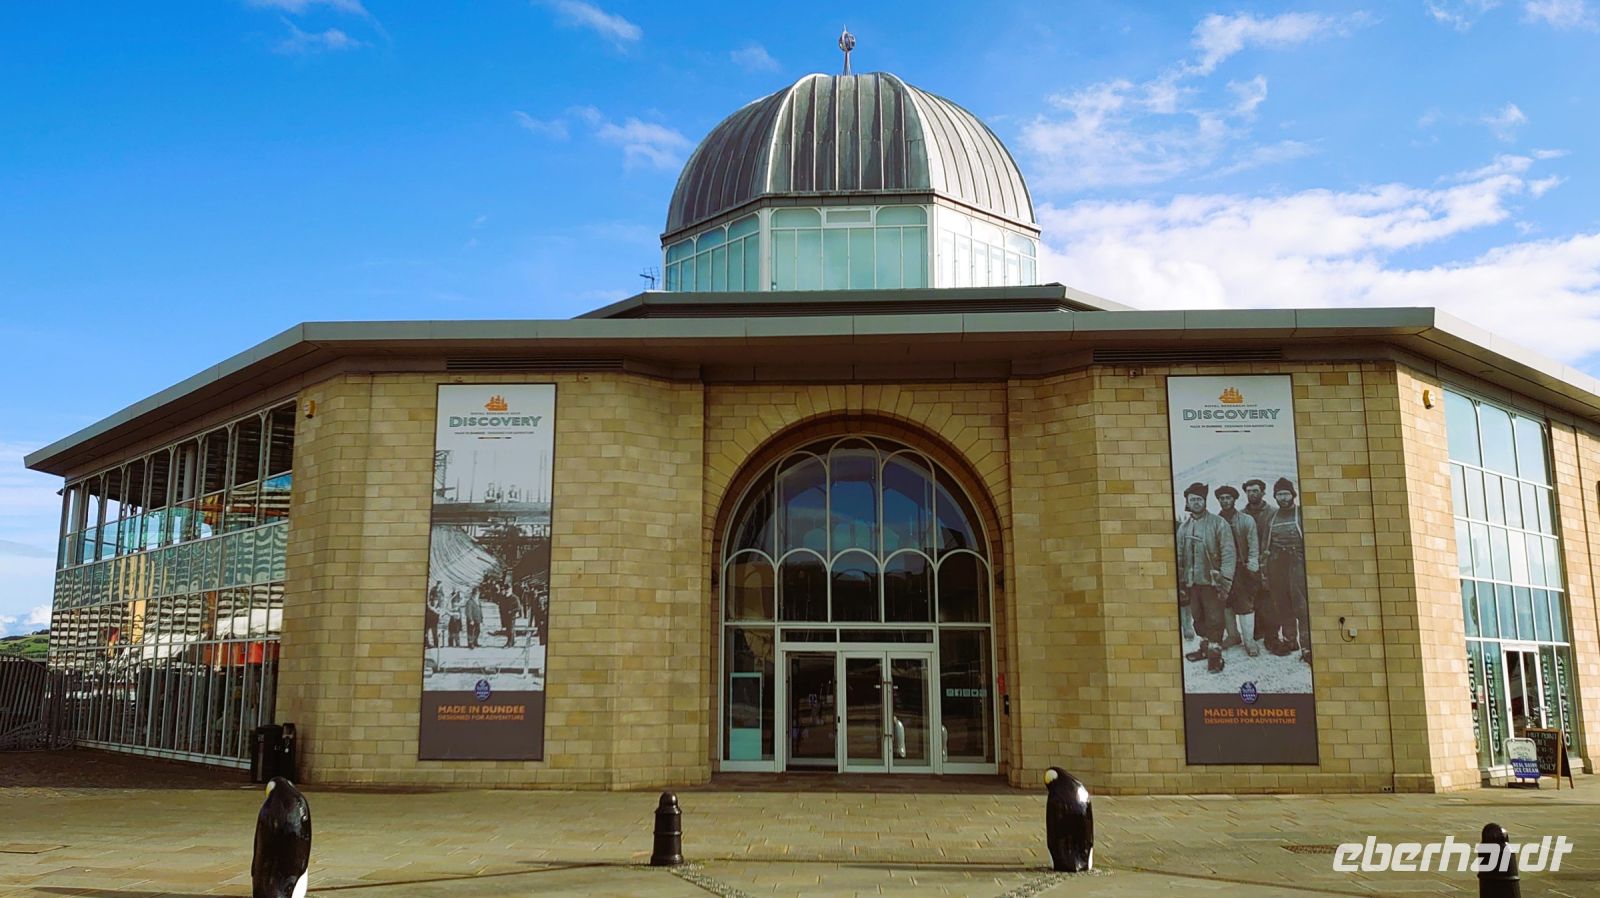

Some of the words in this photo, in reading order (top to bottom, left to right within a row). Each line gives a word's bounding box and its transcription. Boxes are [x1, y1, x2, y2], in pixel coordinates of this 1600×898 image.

[449, 416, 542, 427] DISCOVERY
[1182, 408, 1280, 420] DISCOVERY
[1557, 655, 1567, 697] Daily
[1485, 652, 1500, 752] Cappuccino
[1542, 655, 1553, 728] hibitions
[438, 705, 466, 713] MADE
[468, 705, 479, 713] IN
[482, 705, 525, 713] DUNDEE
[1204, 708, 1234, 717] MADE
[1237, 708, 1248, 717] IN
[1250, 708, 1296, 717] DUNDEE
[1562, 706, 1571, 746] Open
